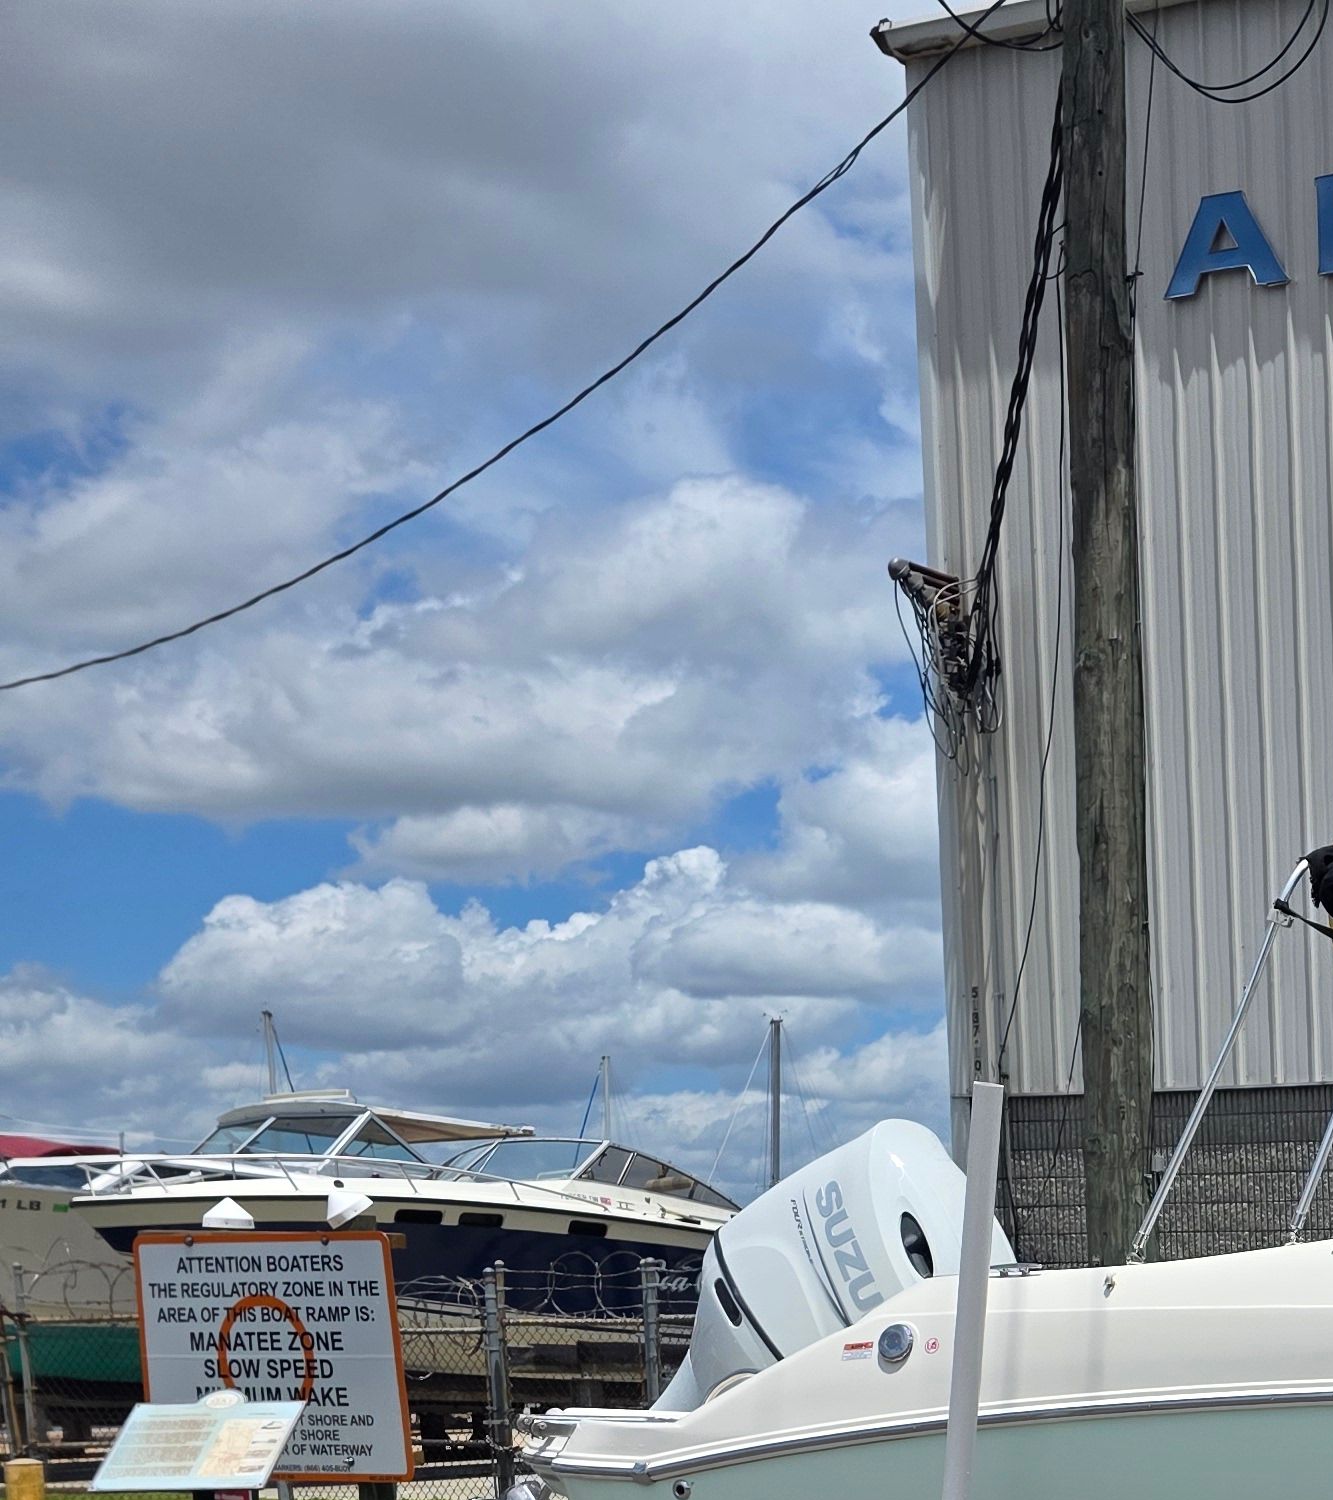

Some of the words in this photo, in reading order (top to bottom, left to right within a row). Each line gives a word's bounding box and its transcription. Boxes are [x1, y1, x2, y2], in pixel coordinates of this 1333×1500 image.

[176, 1256, 262, 1274] ATTENTION
[267, 1254, 344, 1272] BOATERS
[149, 1283, 178, 1298] THE
[181, 1282, 279, 1298] REGULATORY
[283, 1281, 324, 1297] ZONE
[328, 1281, 344, 1296] IN
[347, 1280, 380, 1296] THE
[157, 1307, 197, 1323] AREA
[201, 1307, 220, 1322] OF
[223, 1307, 256, 1322] THIS
[261, 1306, 301, 1322] BOAT
[306, 1306, 351, 1322] RAMP
[355, 1306, 376, 1321] IS:
[189, 1332, 282, 1352] MANATEE
[286, 1331, 344, 1351] ZONE
[204, 1359, 260, 1379] SLOW
[266, 1358, 334, 1379] SPEED
[286, 1386, 350, 1407] WAKE
[308, 1414, 347, 1426] SHORE
[350, 1414, 374, 1426] AND
[300, 1429, 340, 1441] SHORE
[292, 1444, 307, 1455] OF
[309, 1444, 373, 1457] WATERWAY
